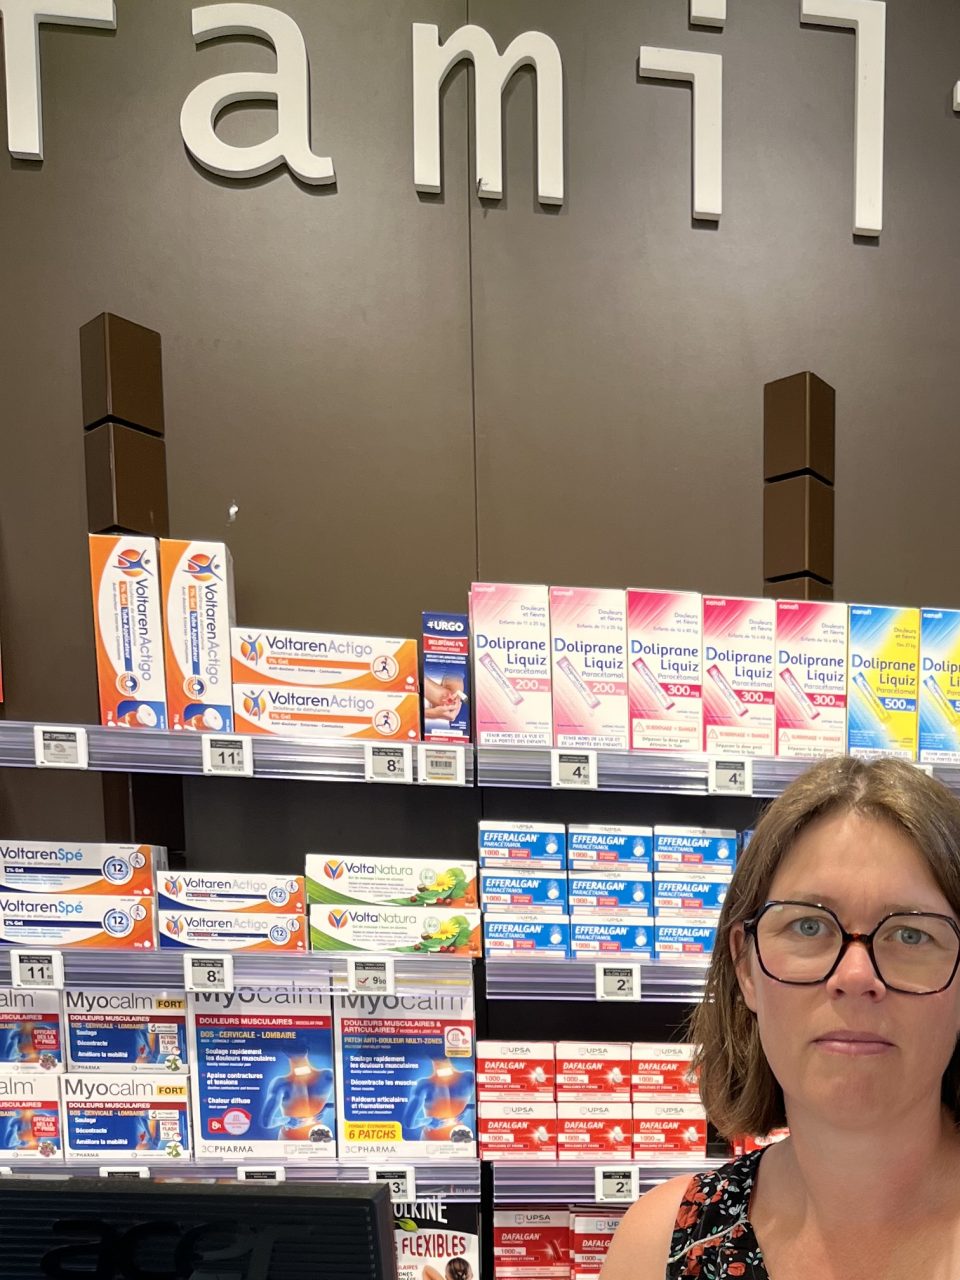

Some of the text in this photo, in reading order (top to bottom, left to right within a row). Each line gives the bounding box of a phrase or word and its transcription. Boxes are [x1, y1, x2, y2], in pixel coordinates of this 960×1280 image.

[135, 578, 152, 681] VoltarenActigo
[434, 620, 464, 632] URGO
[266, 635, 372, 657] VoltarenActigo
[476, 634, 546, 652] Doliprane
[554, 637, 623, 655] Doliprane
[631, 639, 699, 658] Doliprane
[507, 653, 547, 670] Liquiz
[705, 647, 772, 664] Doliprane
[778, 650, 844, 668] Doliprane
[584, 657, 624, 673] Liquiz
[660, 658, 699, 673] Liquiz
[851, 654, 916, 672] Doliprane
[735, 666, 773, 680] Liquiz
[807, 669, 844, 683] Liquiz
[515, 679, 538, 690] 200
[879, 673, 916, 688] Liquiz
[592, 683, 615, 694] 200
[667, 685, 690, 696] 300
[268, 691, 374, 711] VoltarenActigo
[741, 691, 764, 702] 300
[813, 695, 835, 705] 300
[484, 832, 538, 843] EFFERALGAN
[573, 834, 626, 846] EFFERALGAN
[658, 837, 712, 848] EFFERALGAN
[0, 847, 83, 862] VoltarenSpé
[111, 863, 124, 873] 12
[344, 862, 413, 875] VoltaNatura
[182, 877, 268, 892] VoltarenActigo
[486, 878, 540, 889] EFFERALGAN
[573, 880, 626, 892] EFFERALGAN
[658, 882, 712, 893] EFFERALGAN
[0, 899, 84, 915] VoltarenSpé
[184, 916, 269, 931] VoltarenActigo
[348, 911, 417, 924] VoltaNatura
[489, 923, 542, 935] EFFERALGAN
[66, 991, 153, 1012] Myocalm
[158, 1000, 183, 1008] FORT
[199, 1017, 239, 1025] DOULEURS
[344, 1026, 395, 1034] ARTICULAIRES
[485, 1061, 525, 1069] DAFALGAN
[563, 1062, 603, 1070] DAFALGAN
[65, 1079, 153, 1099] Myocalm
[349, 1130, 396, 1140] 6 PATCHS
[402, 1234, 466, 1258] FLEXIBLES
